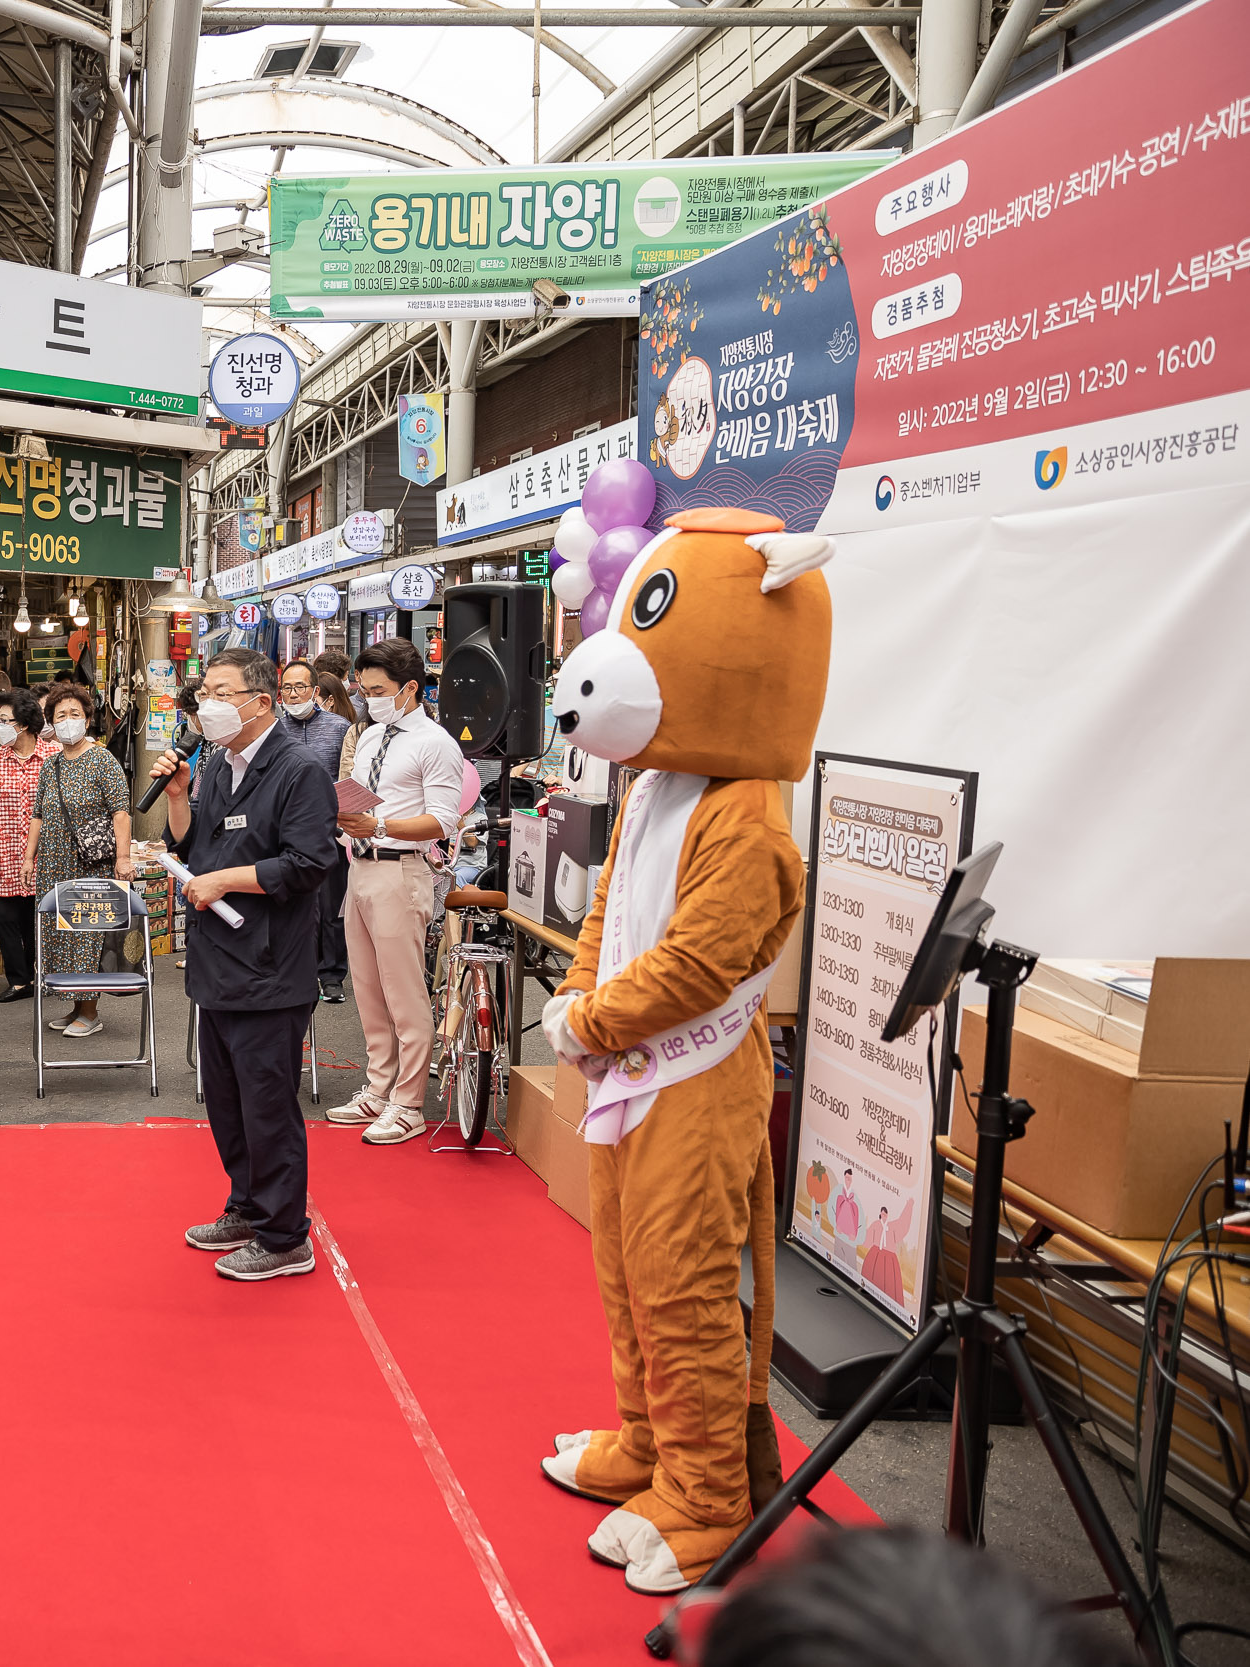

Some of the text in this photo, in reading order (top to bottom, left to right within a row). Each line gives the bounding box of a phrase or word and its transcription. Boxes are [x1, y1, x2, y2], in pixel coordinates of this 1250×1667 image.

[687, 176, 766, 192] 자양전통시장에서
[687, 189, 712, 204] 5만원
[714, 188, 734, 203] 이상
[735, 188, 756, 202] 구매
[758, 187, 788, 201] 영수증
[880, 225, 955, 278] 자양강장데이
[963, 183, 1054, 248] 용마노래자랑
[1062, 150, 1136, 206] 초대가수
[1139, 127, 1181, 177] 공연
[890, 173, 951, 220] 주요행사
[330, 215, 359, 227] ZERO
[371, 183, 618, 251] 용기내 자양!
[324, 227, 364, 241] WASTE
[708, 223, 725, 234] 추첨
[726, 222, 742, 234] 증정
[511, 254, 622, 269] 자양전통시장 고객쉼터 1층
[636, 263, 658, 274] 친환경
[354, 277, 470, 291] 09.03(토) 오후 5:00~6:00
[555, 276, 585, 286] 드립니다
[407, 298, 527, 309] 자양전통시장 문화관광형시장 육성사업단
[886, 284, 945, 326] 경품추첨
[916, 335, 958, 372] 물걸레
[1042, 294, 1097, 335] 초고속
[719, 329, 774, 366] 자양전통시장
[227, 352, 282, 375] 진선명
[235, 377, 273, 397] 청과
[716, 352, 794, 413] 자양강장
[898, 336, 1216, 436] 일시: 2022년 9월 2일(금) 12:30 16:00
[128, 389, 184, 409] T.444-0772
[243, 405, 263, 417] 과일
[416, 418, 426, 434] 6
[715, 393, 839, 464] 한마음 대축제
[1074, 423, 1238, 476] 소상공인시장진흥공단
[900, 470, 981, 502] 중소벤처기업부
[402, 572, 424, 585] 삼호
[310, 592, 336, 601] 축산사랑
[401, 584, 424, 597] 축산
[278, 607, 298, 616] 건강원
[281, 599, 295, 607] 현대
[240, 606, 256, 623] 회
[832, 799, 938, 835] 자양전통시장 자양강장 한마음 대축제
[824, 820, 947, 881] 삼거리행사 일정
[75, 902, 111, 911] 광진구청장
[885, 911, 914, 937] 개회식
[859, 1039, 923, 1085] 경품추첨&시상식
[862, 1097, 910, 1138] 자양강장데이
[879, 1125, 887, 1142] &
[856, 1129, 913, 1175] 수재민모금행사
